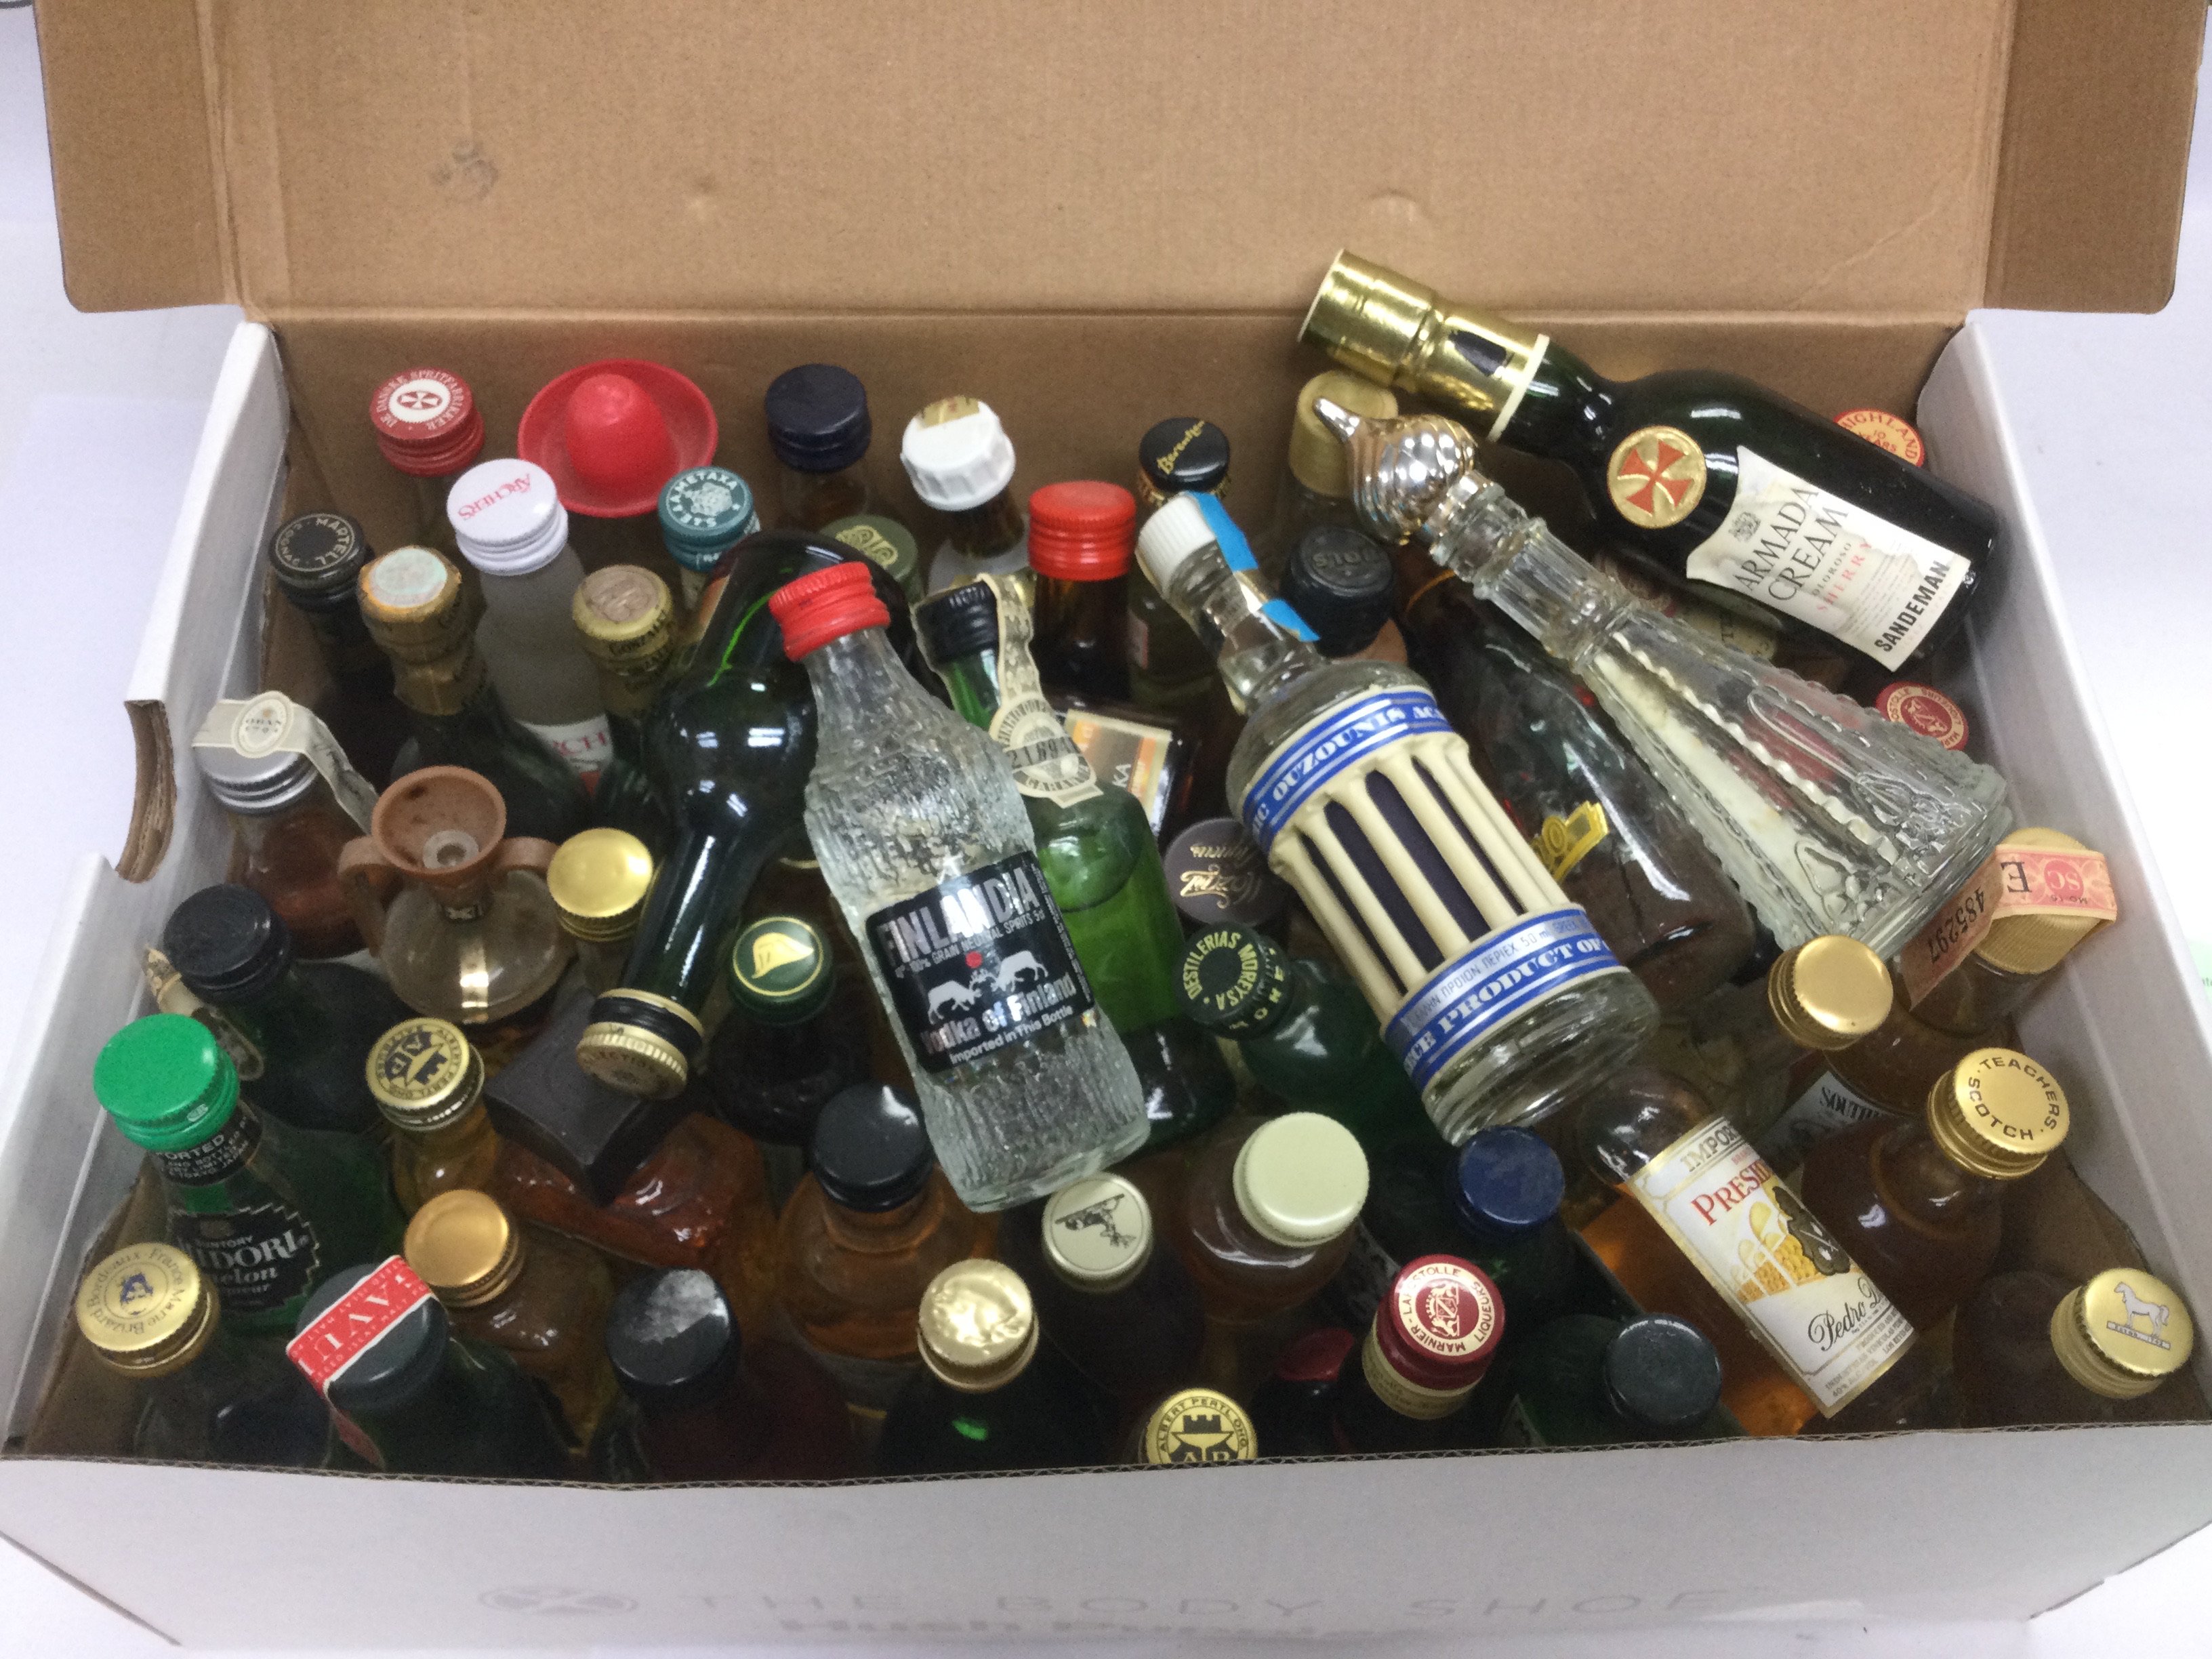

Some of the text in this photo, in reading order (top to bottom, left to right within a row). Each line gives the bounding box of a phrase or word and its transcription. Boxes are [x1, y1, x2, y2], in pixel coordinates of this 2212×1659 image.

[457, 472, 532, 521] ARCHERS
[1732, 487, 1819, 592] ARMADA
[1767, 508, 1849, 601] CREAM
[1812, 542, 1853, 599] OLOROSO
[1817, 537, 1873, 611] SHERRY
[1875, 560, 1950, 653] SANDEMAN
[1271, 706, 1407, 804] OUZOUNIS
[1929, 861, 2032, 967] 485297 E
[2049, 872, 2083, 893] SC
[880, 866, 1042, 968] FINLANDIA
[930, 942, 960, 965] GRAIN
[1002, 911, 1033, 935] SPIRITS
[1519, 931, 1538, 948] 50
[1008, 972, 1078, 1022] Finland
[1182, 930, 1243, 1001] DESTILERIAS
[1215, 943, 1258, 1011] MOREYSA
[1441, 941, 1574, 1039] PRODUCT
[1576, 936, 1603, 955] OF
[950, 1006, 1073, 1065] Imported in This Bottle
[1967, 1056, 2060, 1141] TEACHERS SCOTCH
[148, 1245, 186, 1284] France
[1470, 1280, 1494, 1344] LIQUEURS
[1806, 1303, 1866, 1353] Pedro
[1157, 1399, 1189, 1452] ALBERT
[1191, 1394, 1231, 1422] PERTL
